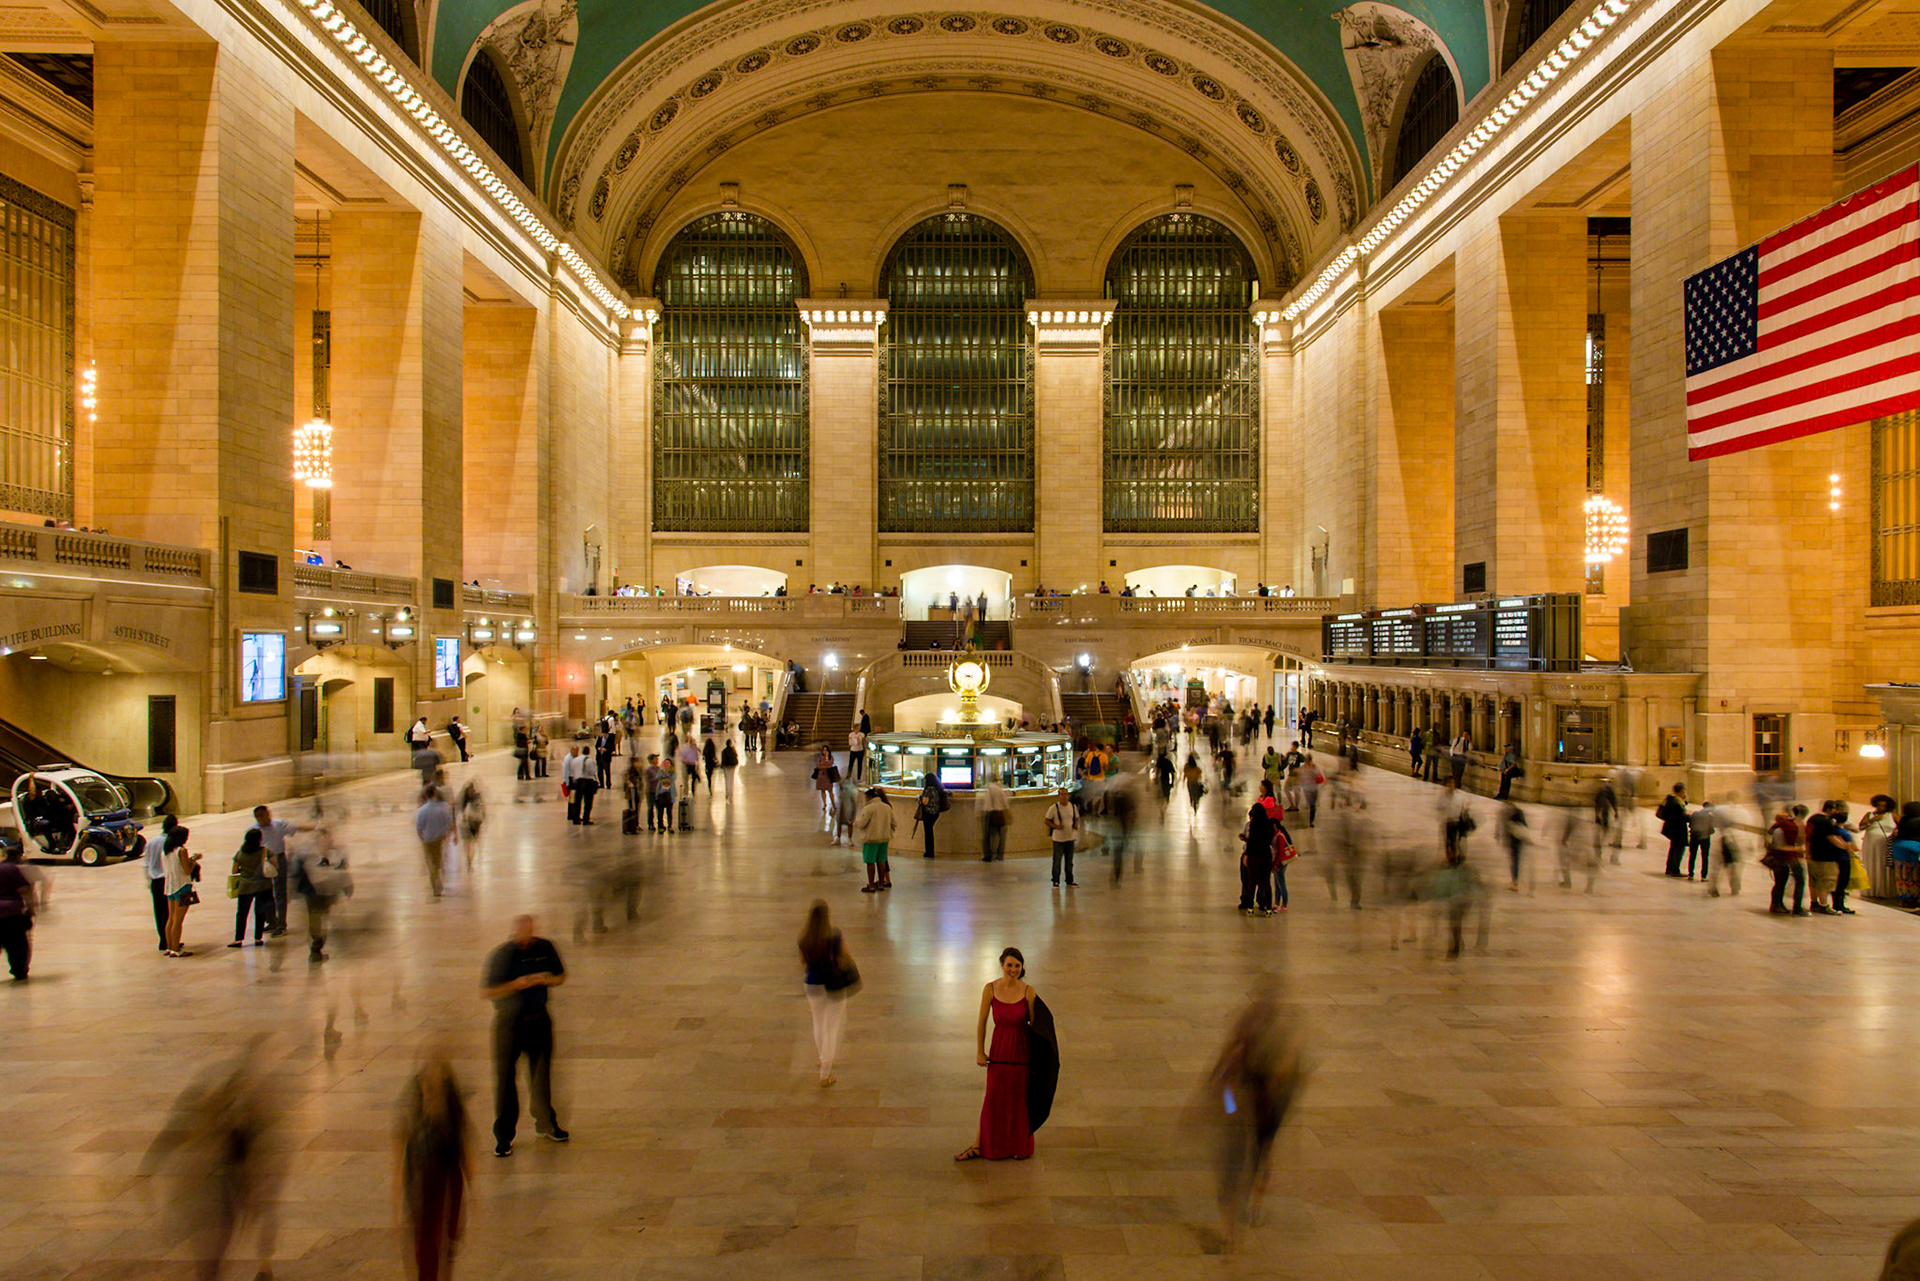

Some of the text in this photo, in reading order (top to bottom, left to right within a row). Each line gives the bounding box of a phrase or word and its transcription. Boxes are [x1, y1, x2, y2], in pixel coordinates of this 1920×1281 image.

[30, 623, 81, 641] BUILDING
[113, 625, 171, 649] 45TH STREET
[1238, 635, 1301, 653] TICKET MACHINES
